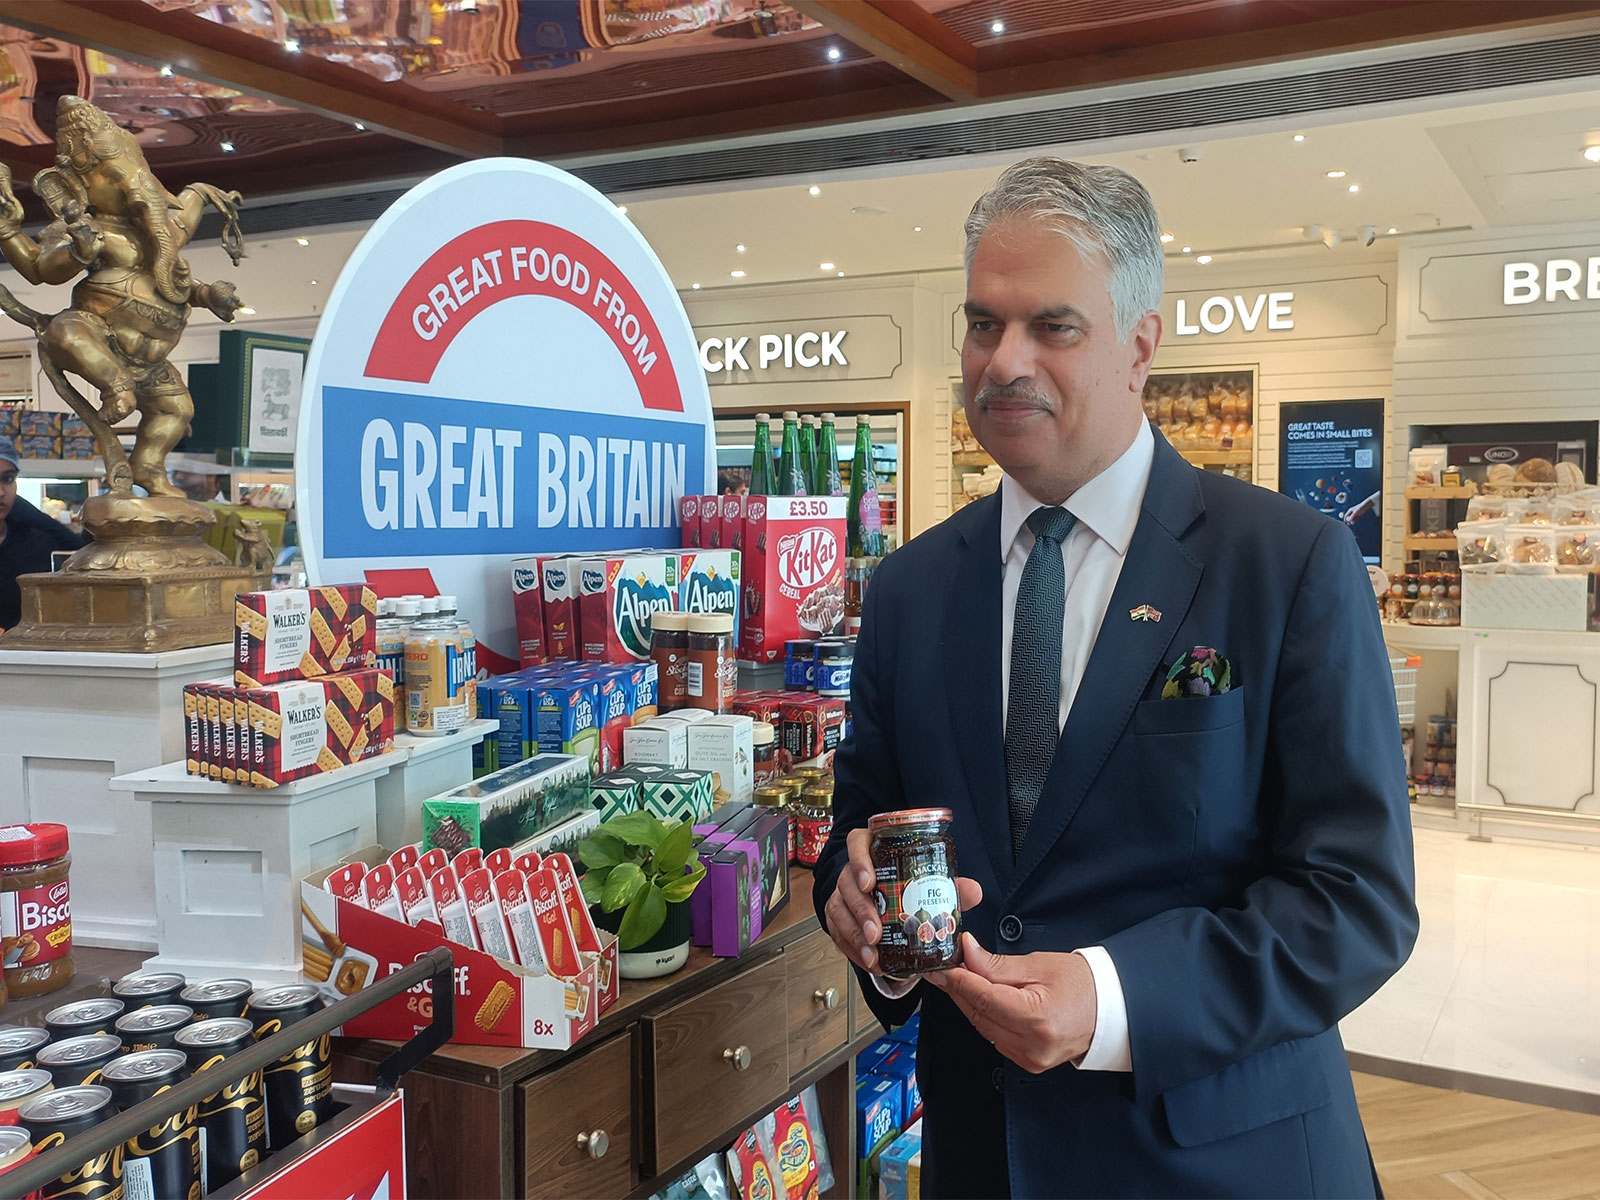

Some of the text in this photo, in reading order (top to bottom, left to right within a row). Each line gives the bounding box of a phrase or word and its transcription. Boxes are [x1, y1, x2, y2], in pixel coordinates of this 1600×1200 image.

[412, 247, 658, 376] GREAT FOOD FROM
[1176, 292, 1295, 336] LOVE
[759, 330, 848, 369] PICK
[1287, 421, 1334, 431] GREAT TASTE
[1287, 428, 1372, 440] COMES IN SMALL BITES
[360, 418, 686, 530] GREAT BRITAIN
[790, 501, 828, 517] £3.50
[786, 531, 835, 587] KitKat
[516, 572, 534, 585] Alpen
[546, 572, 565, 585] Alpen
[583, 573, 603, 586] Alpen
[689, 580, 734, 613] Alpen
[779, 585, 801, 600] CEREAL
[619, 587, 669, 628] Alpen
[274, 635, 303, 644] SHORTBREAD
[279, 642, 298, 650] FINGERS
[637, 693, 653, 708] SOUP
[609, 702, 626, 719] SOUP
[576, 714, 593, 731] SOUP
[290, 729, 320, 742] SHORTBREAD
[295, 737, 314, 747] FINGERS
[913, 864, 949, 877] MACKAYS
[927, 888, 942, 898] FIG
[534, 890, 559, 916] Biscoff
[917, 897, 950, 906] PRESERVE
[534, 1019, 554, 1036] 8x
[873, 1117, 892, 1143] SOUP
